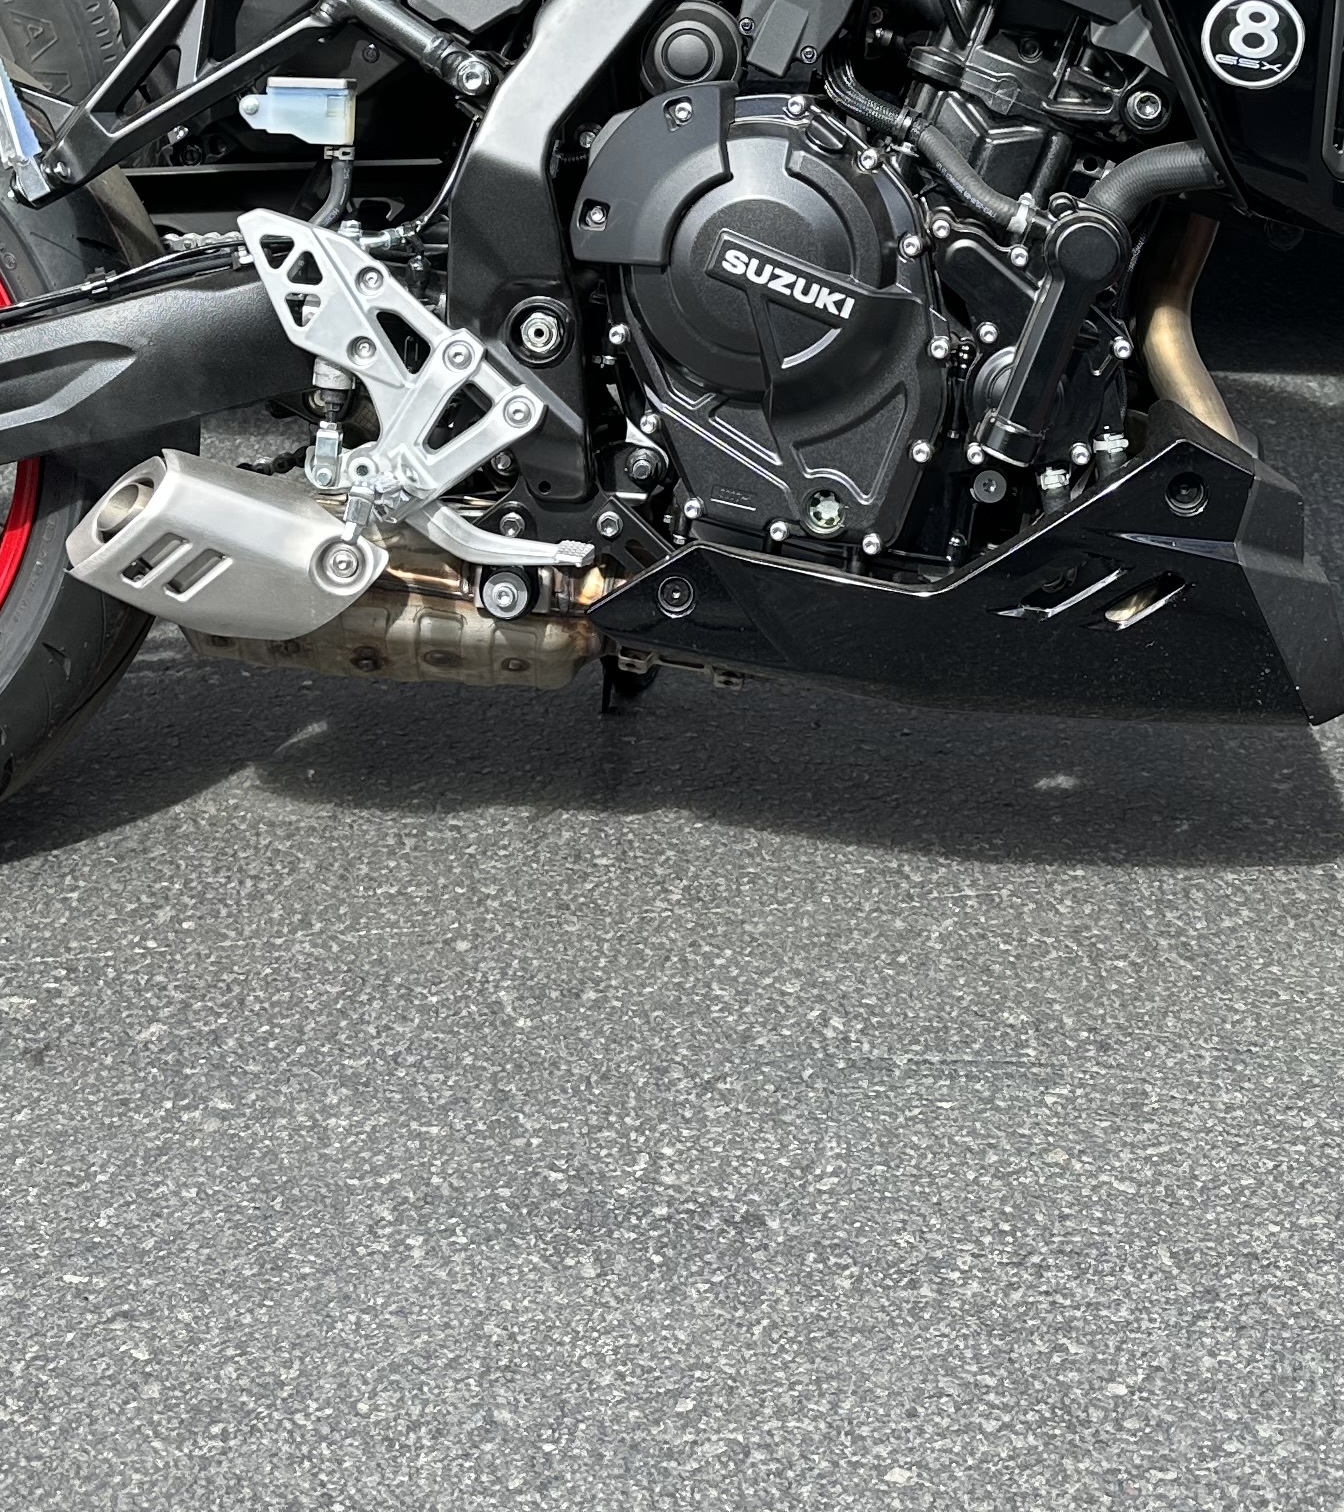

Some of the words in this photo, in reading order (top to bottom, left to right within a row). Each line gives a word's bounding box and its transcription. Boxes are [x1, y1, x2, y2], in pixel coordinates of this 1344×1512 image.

[1228, 0, 1280, 59] 8
[1215, 53, 1283, 73] GSX
[721, 249, 856, 320] SUZUKI
